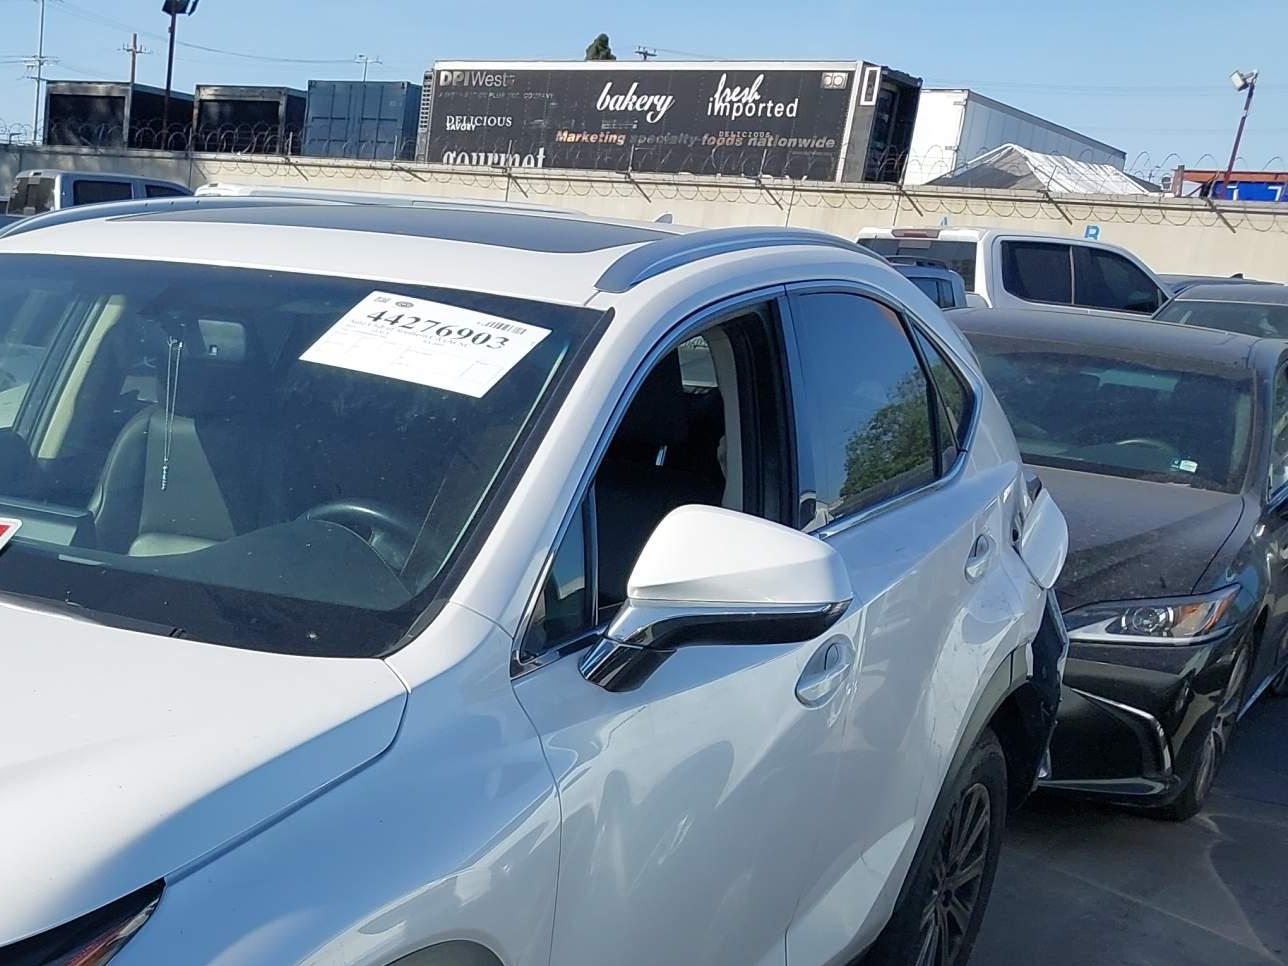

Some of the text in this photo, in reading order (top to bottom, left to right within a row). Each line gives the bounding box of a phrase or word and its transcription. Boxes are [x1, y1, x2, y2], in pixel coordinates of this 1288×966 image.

[714, 73, 764, 103] fresh
[596, 81, 676, 124] bakery
[707, 97, 799, 120] imported
[446, 115, 512, 127] DELICIOUS
[555, 131, 626, 146] Marketing
[701, 133, 743, 146] foods
[747, 134, 835, 148] nationwide
[367, 309, 511, 350] 44276903
